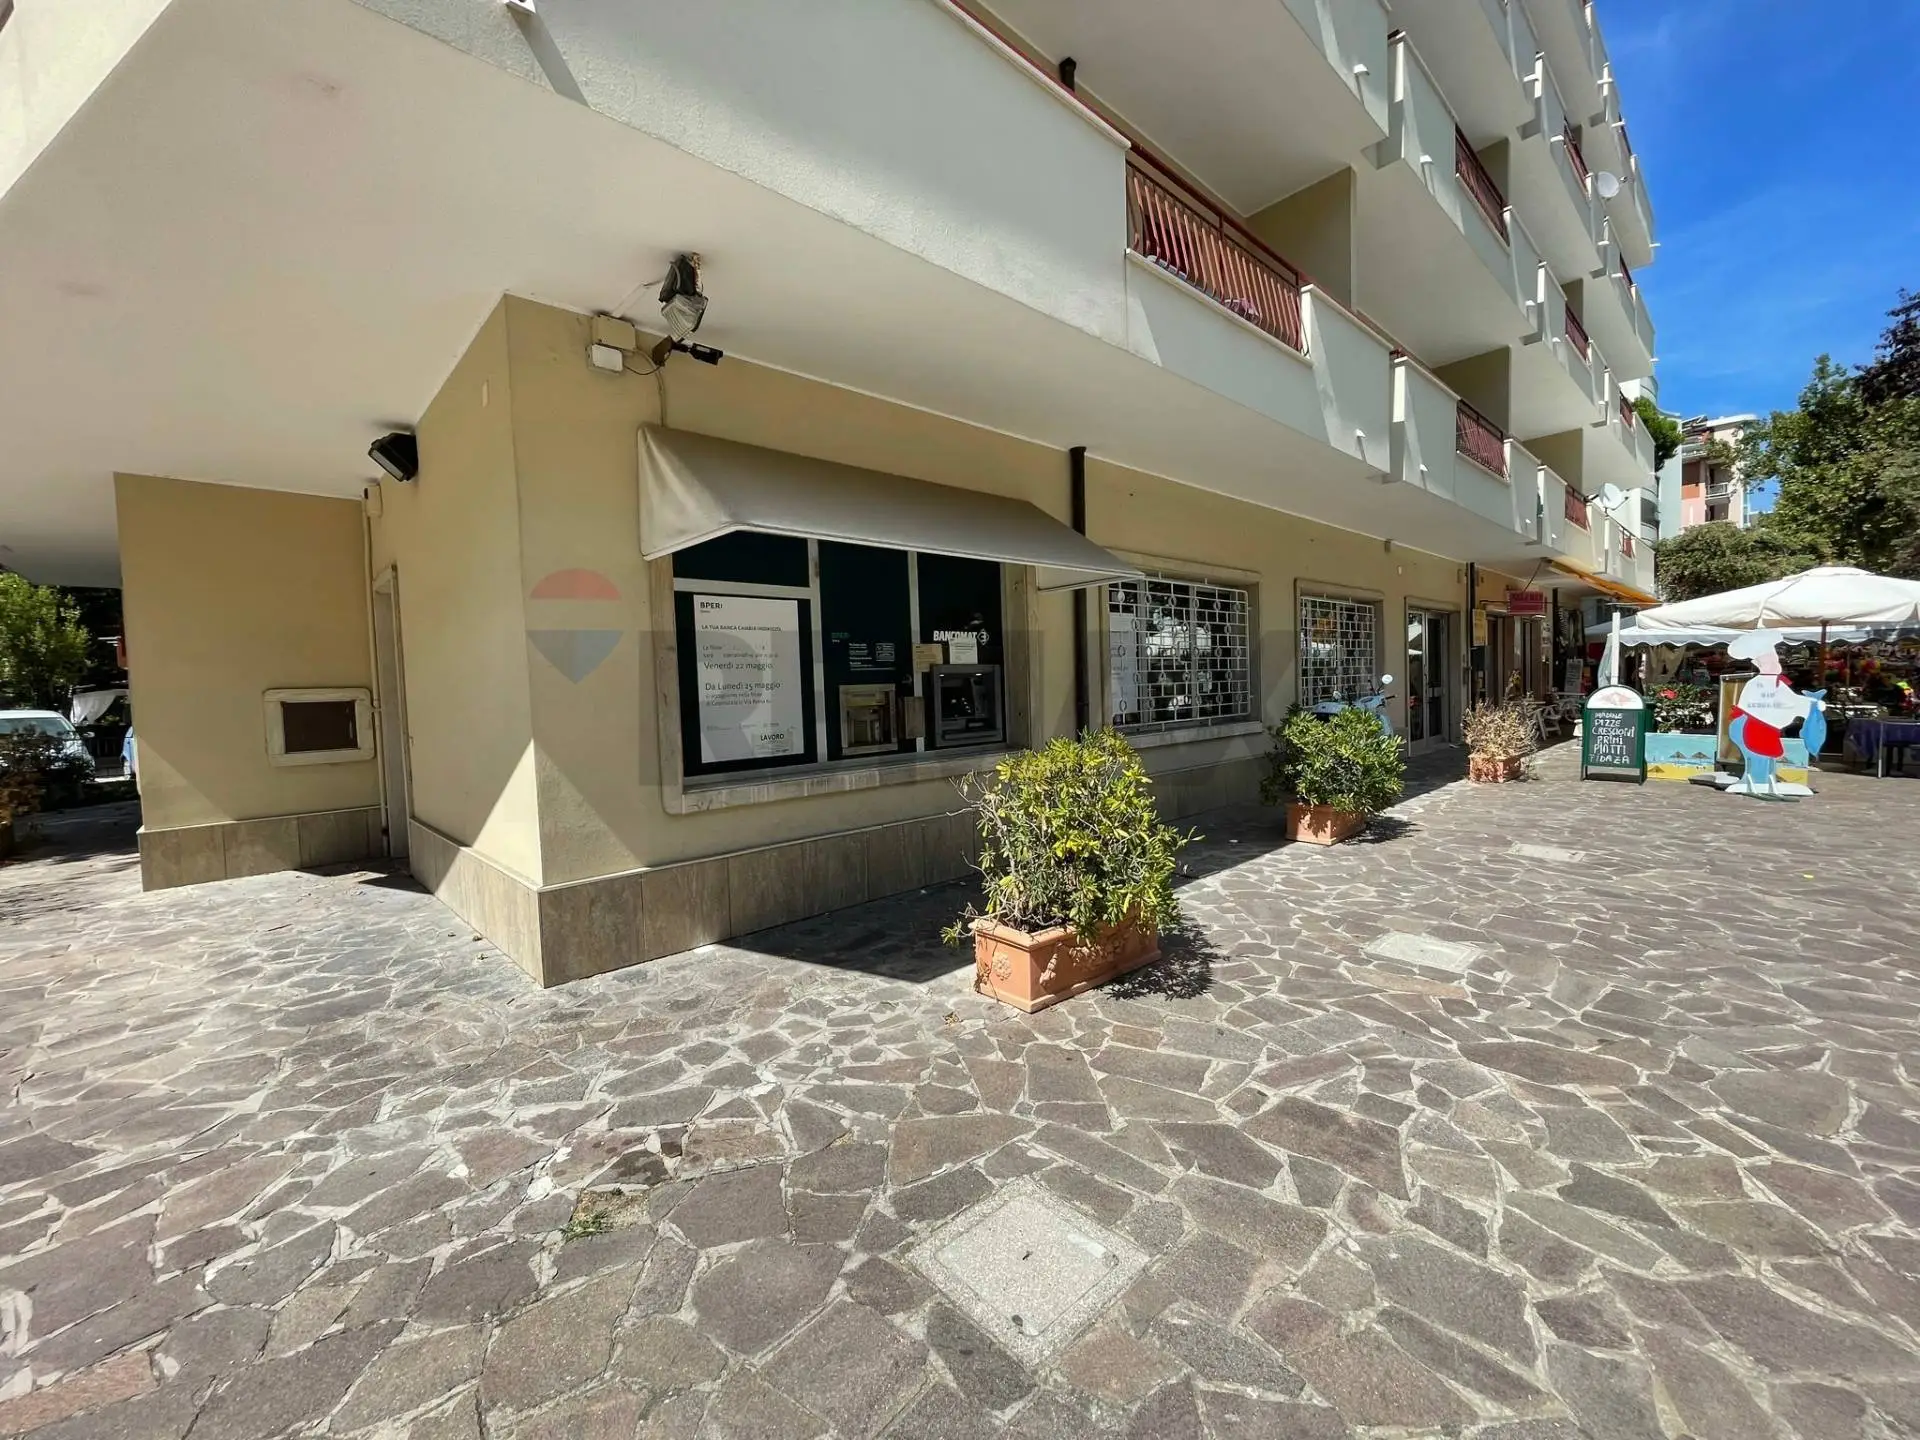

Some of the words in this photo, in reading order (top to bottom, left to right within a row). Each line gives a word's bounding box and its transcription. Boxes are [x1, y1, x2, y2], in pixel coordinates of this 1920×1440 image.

[933, 630, 978, 641] BANCOMAT
[705, 682, 716, 690] Da
[1594, 718, 1622, 727] PIZZE
[760, 733, 785, 741] LAVORO
[1597, 735, 1623, 745] PRIMI
[1593, 742, 1626, 755] PIATTI
